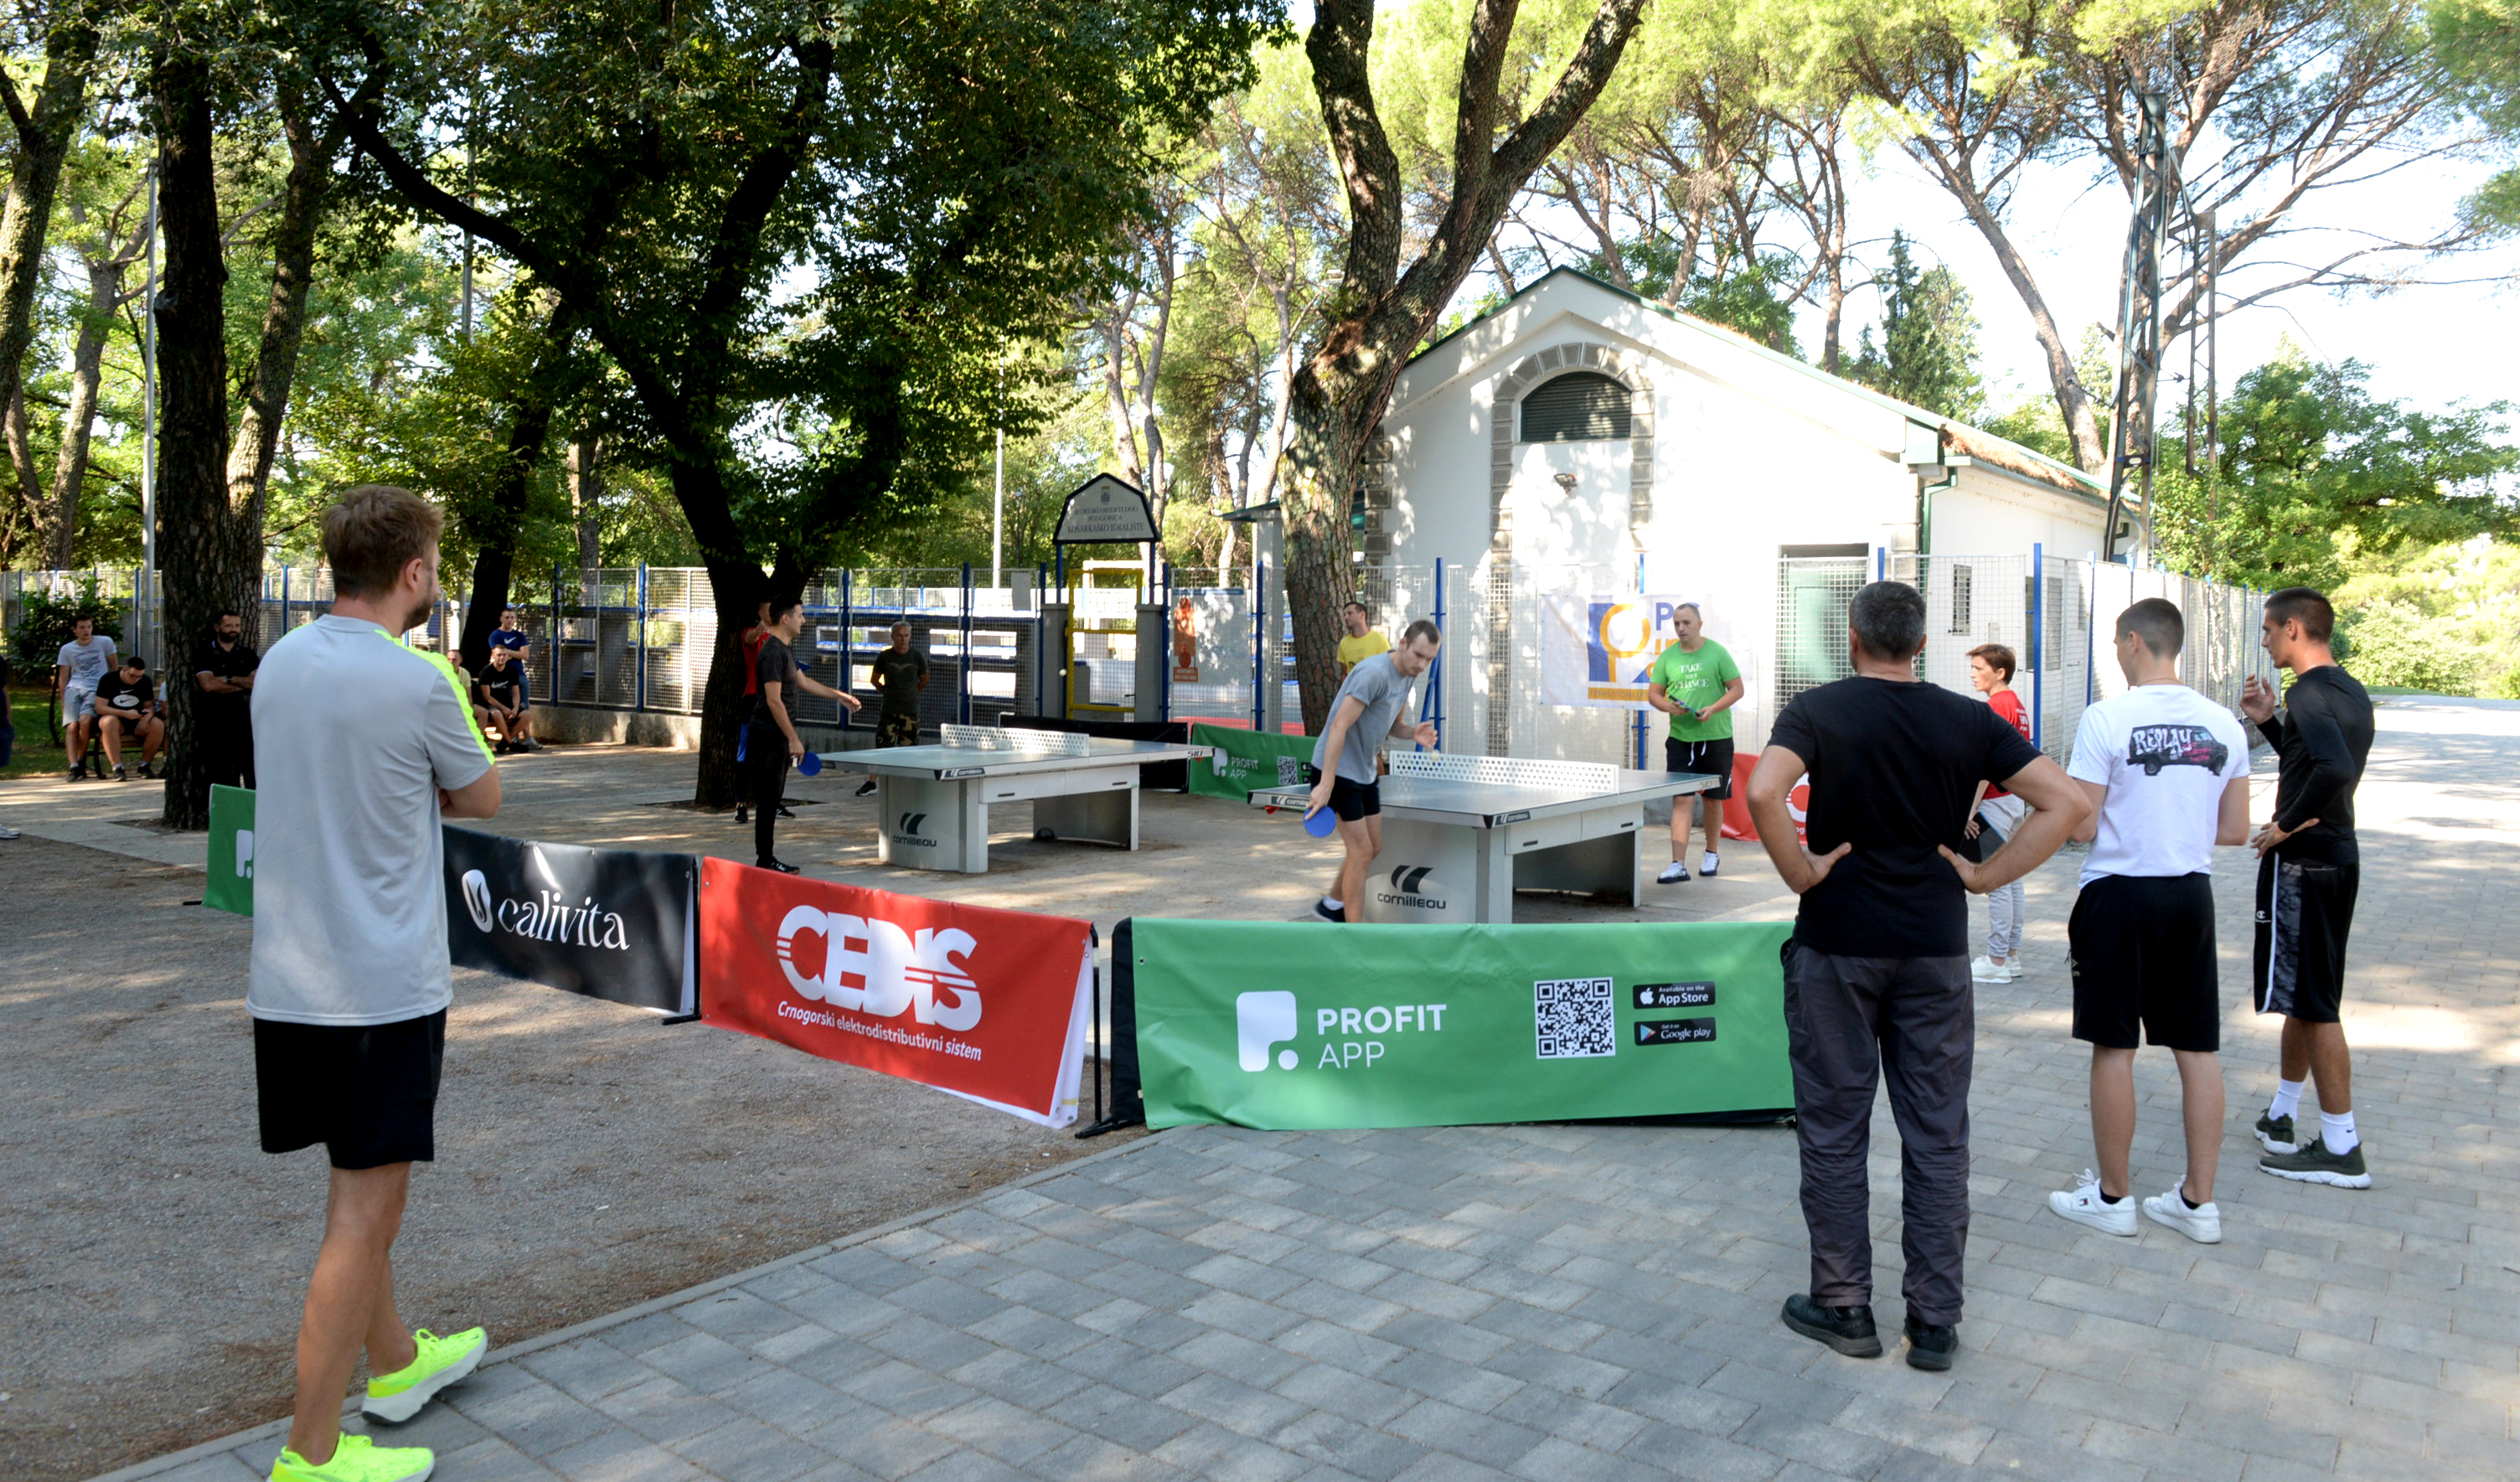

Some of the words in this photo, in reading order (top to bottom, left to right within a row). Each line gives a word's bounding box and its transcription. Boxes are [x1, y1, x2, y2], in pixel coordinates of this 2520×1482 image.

[1110, 521, 1144, 531] IGRALIŠTE
[1679, 663, 1702, 674] TAKE
[1231, 756, 1258, 770] PROFIT
[1229, 768, 1247, 779] APP
[1377, 893, 1446, 909] cornilleau
[498, 891, 630, 950] calivita
[777, 905, 983, 1031] CEDIS
[1658, 994, 1681, 1006] App
[1681, 993, 1709, 1004] Store
[1318, 1004, 1447, 1035] PROFIT
[777, 1000, 835, 1026] Crnogorski
[836, 1015, 943, 1051] elektrodistributivni
[945, 1037, 982, 1061] sistem
[1660, 1028, 1691, 1040] Google
[1693, 1028, 1711, 1039] play
[1318, 1041, 1385, 1070] APP
